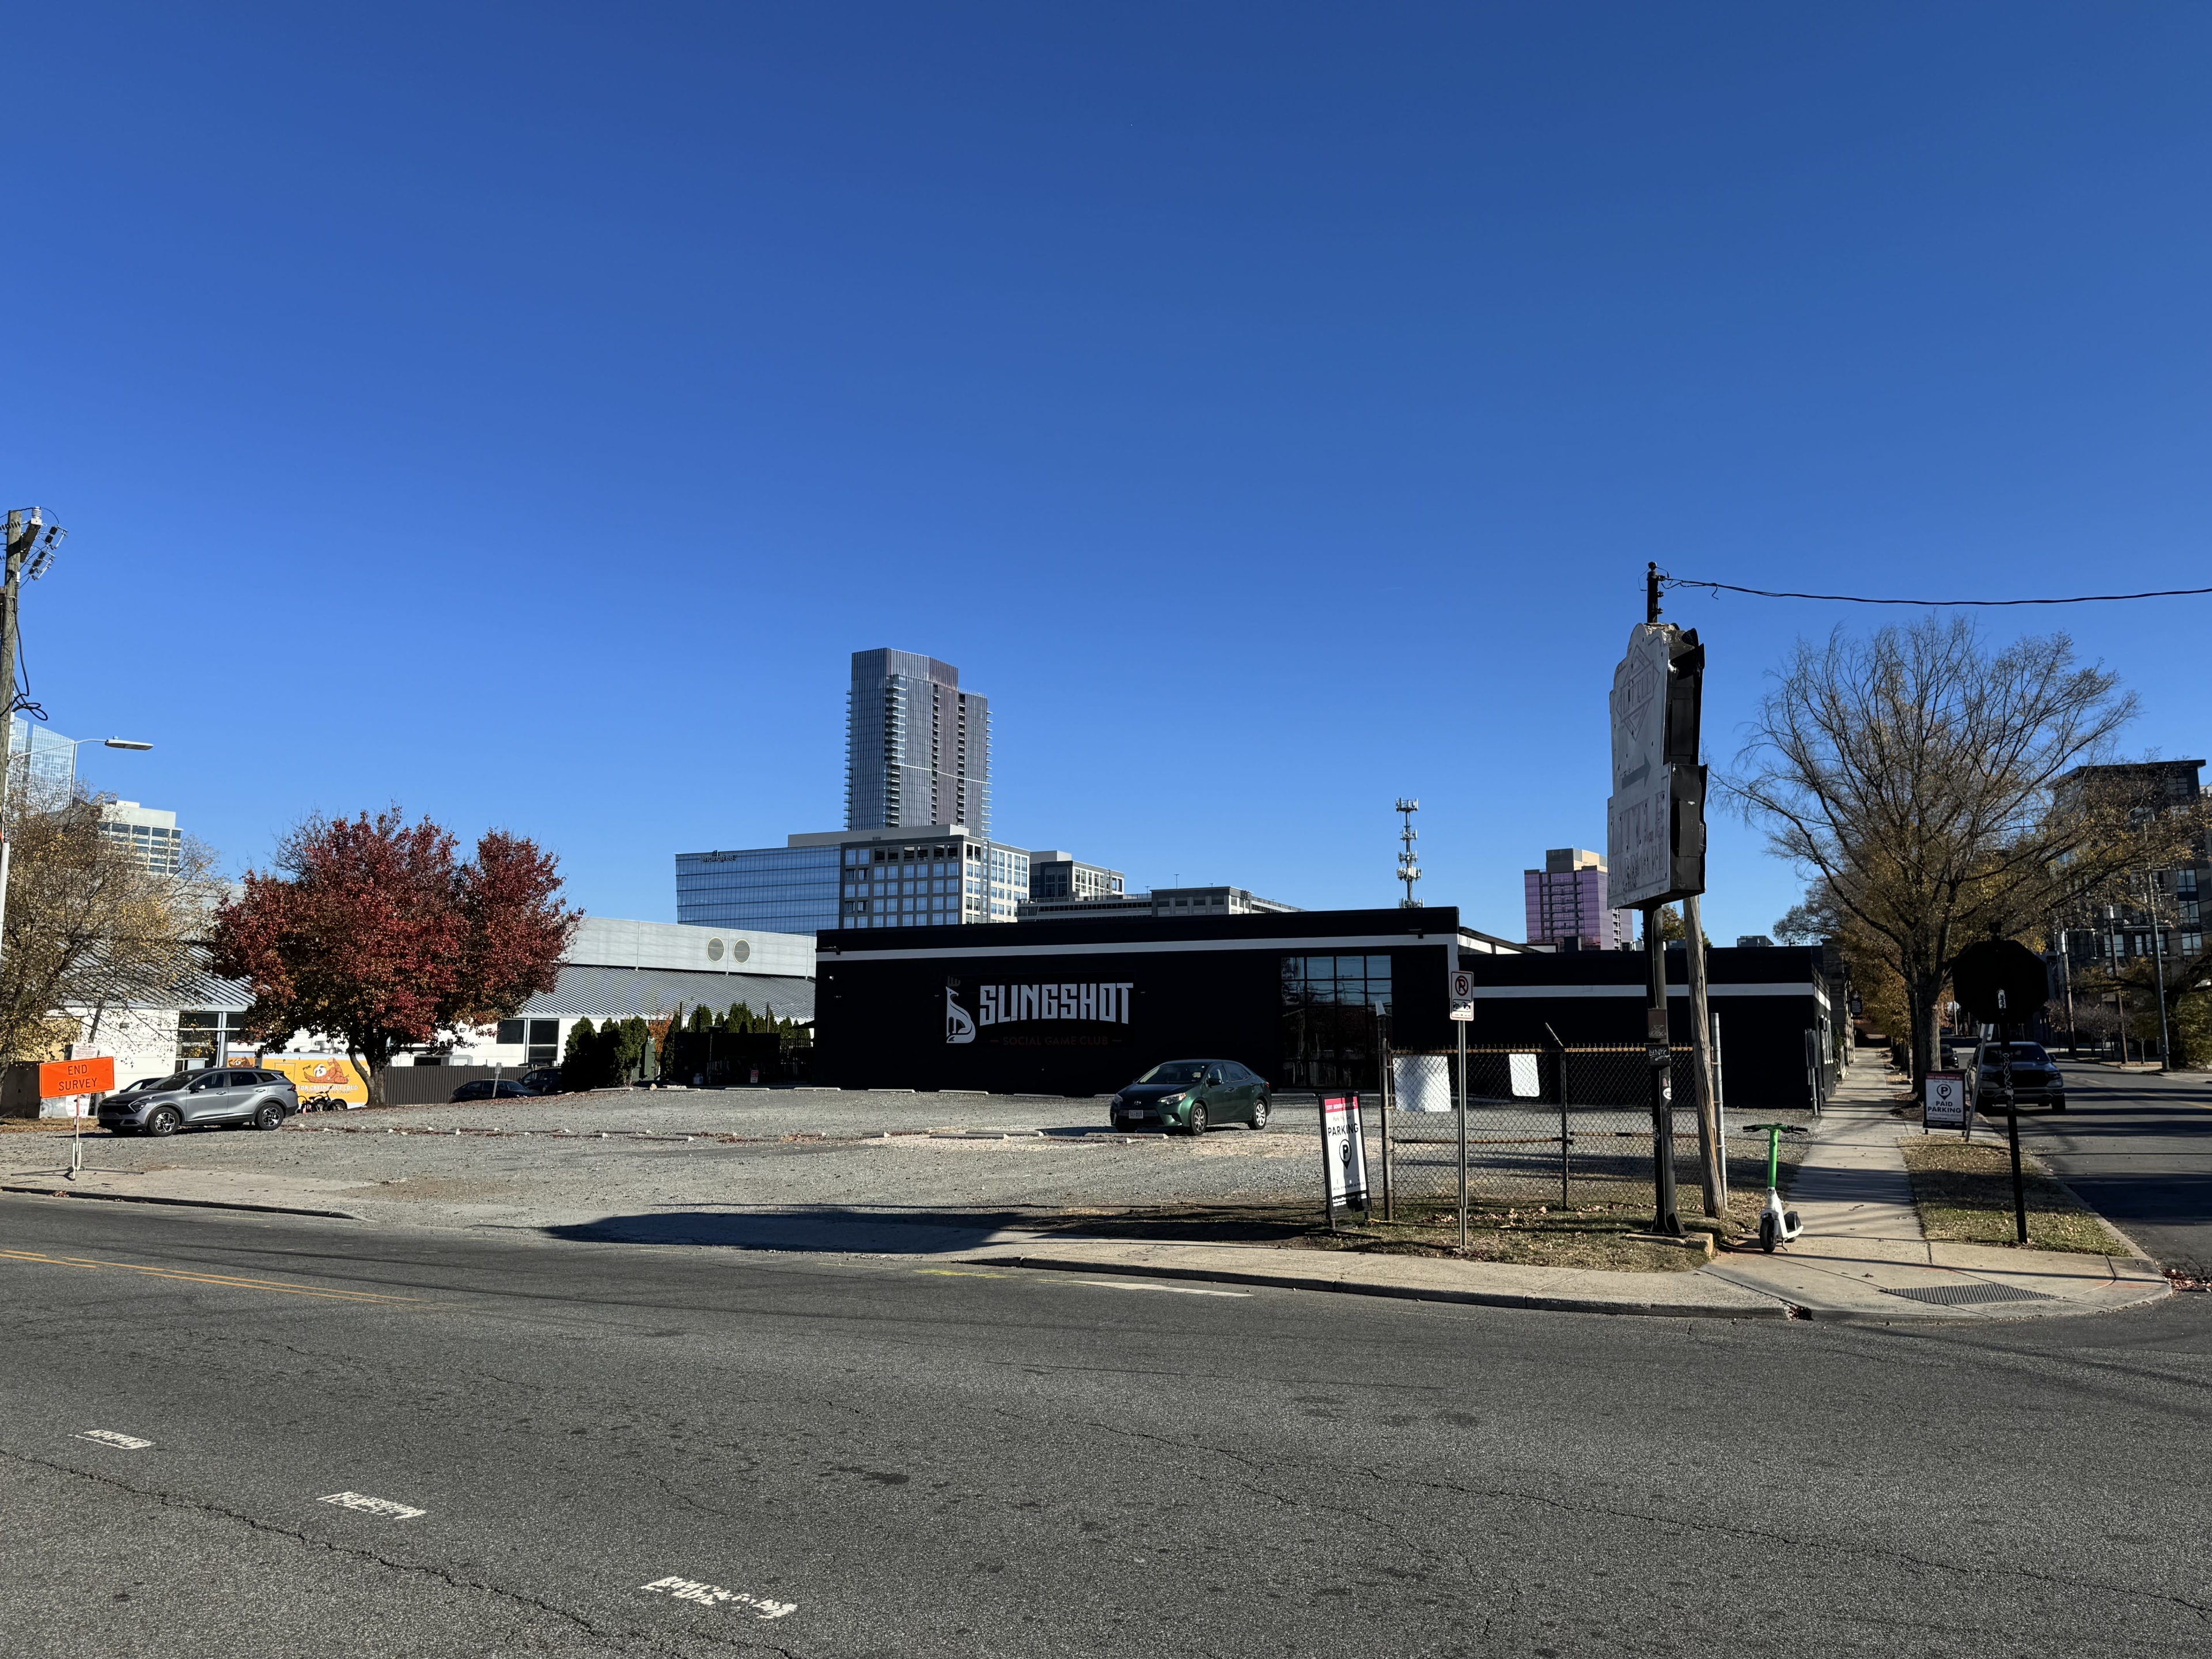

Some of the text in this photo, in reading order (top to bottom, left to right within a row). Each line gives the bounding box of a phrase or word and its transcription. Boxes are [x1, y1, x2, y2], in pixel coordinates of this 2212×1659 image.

[979, 983, 1134, 1026] SLINGSHOT
[1003, 1035, 1108, 1046] SOCIAL GAME CLUB
[67, 1064, 88, 1075] END
[58, 1077, 97, 1091] SURVEY
[1327, 1123, 1359, 1137] PARKING
